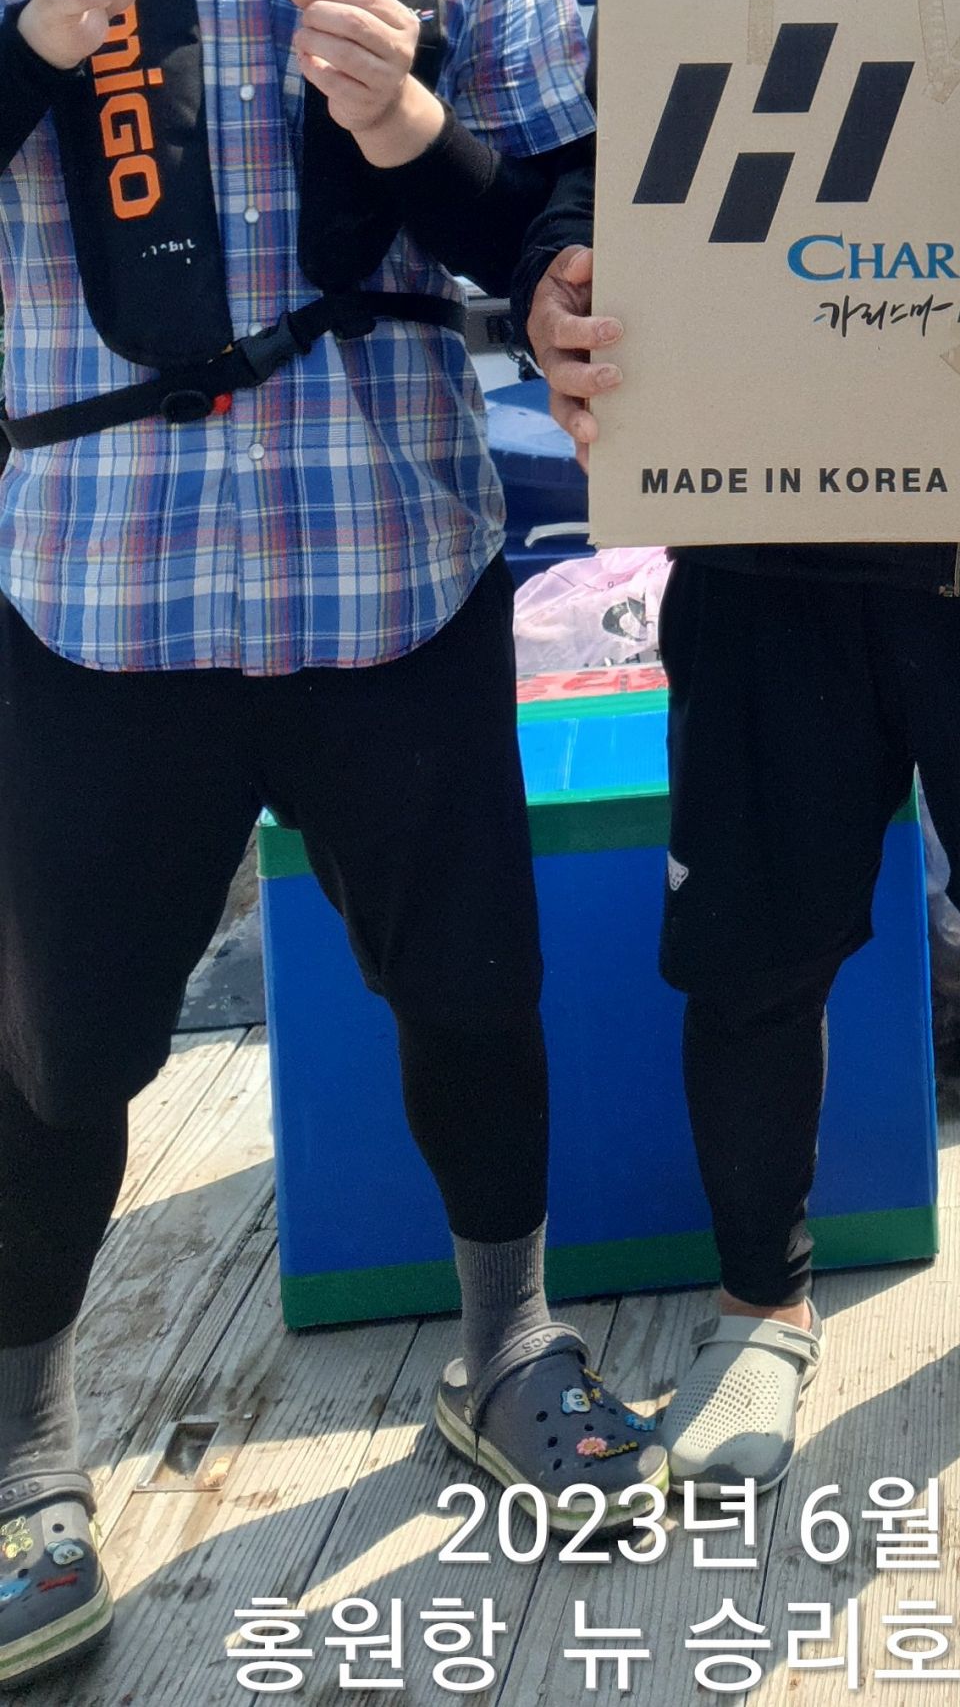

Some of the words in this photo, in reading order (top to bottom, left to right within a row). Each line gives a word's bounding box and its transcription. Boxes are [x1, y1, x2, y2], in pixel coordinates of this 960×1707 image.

[641, 468, 748, 494] MADE
[766, 468, 801, 494] IN
[819, 467, 948, 494] KOREA
